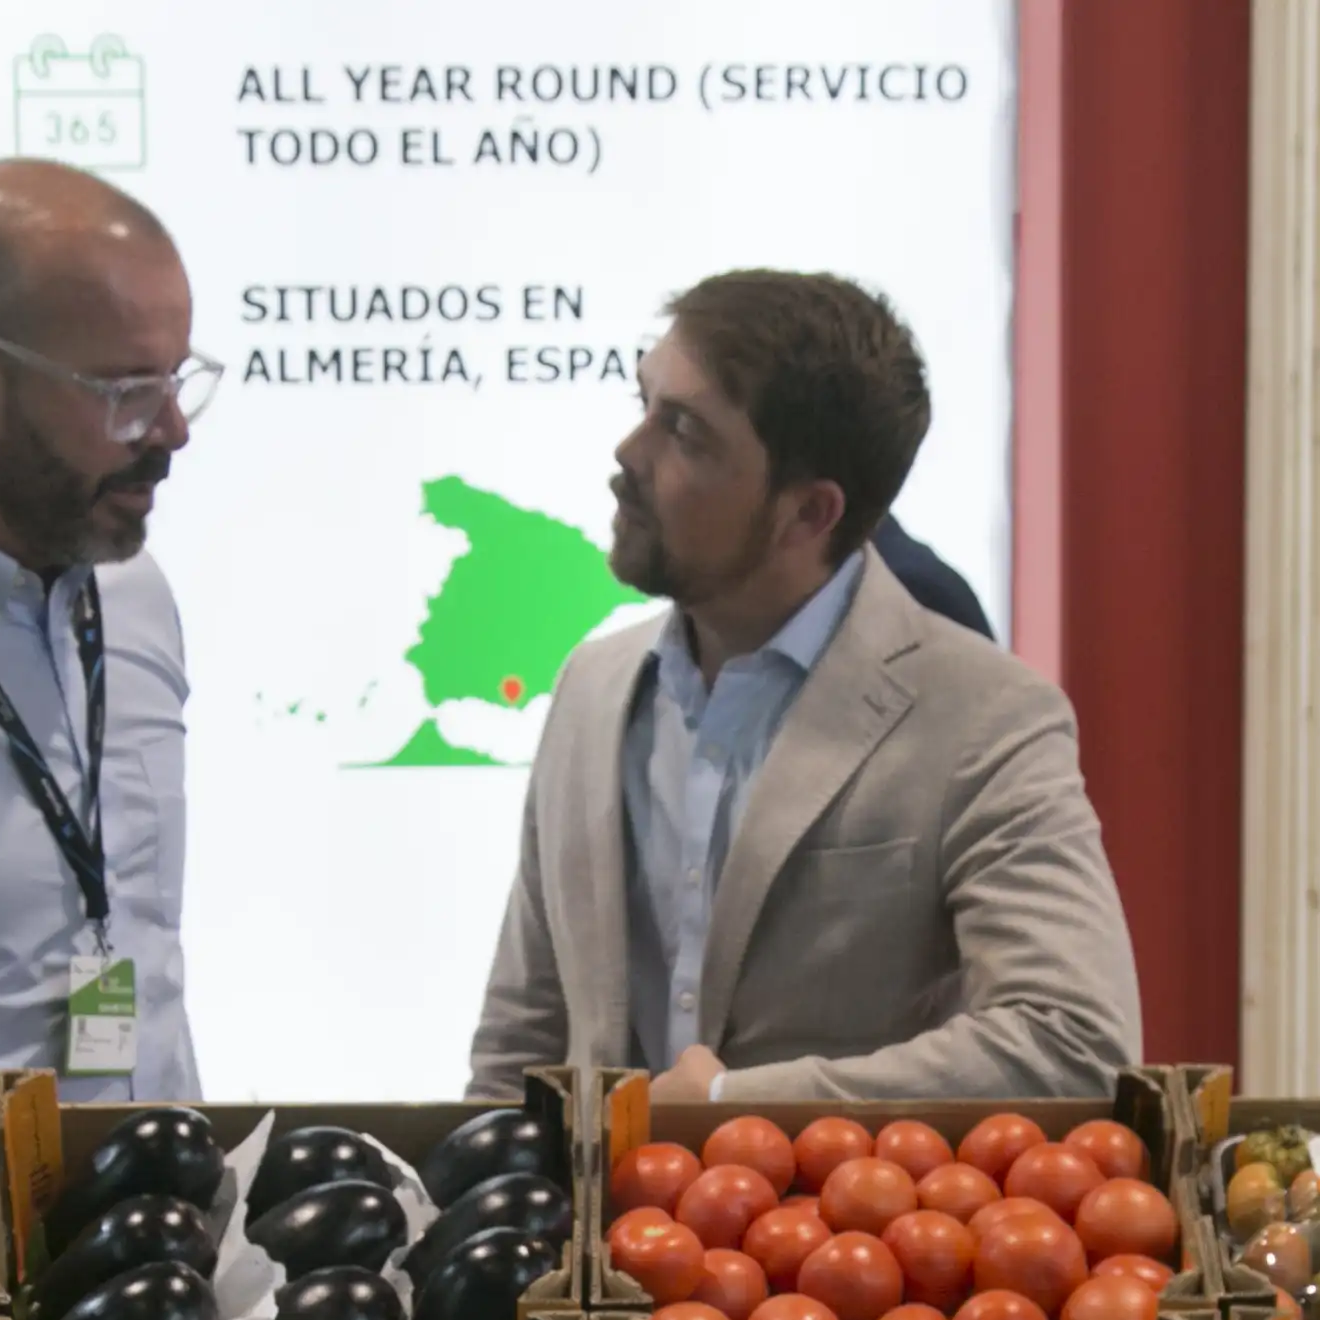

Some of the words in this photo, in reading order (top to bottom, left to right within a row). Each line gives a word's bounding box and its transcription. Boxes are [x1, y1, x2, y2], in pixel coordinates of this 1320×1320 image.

[238, 66, 323, 102] ALL
[344, 66, 474, 102] YEAR
[493, 65, 678, 102] ROUND
[698, 65, 969, 110] (SERVICIO
[45, 113, 117, 146] 365
[237, 126, 380, 166] TODO
[400, 128, 454, 165] EL
[473, 116, 602, 174] AÑO)
[242, 285, 501, 322] SITUADOS
[522, 287, 583, 321] EN
[243, 333, 492, 390] ALMERÍA,
